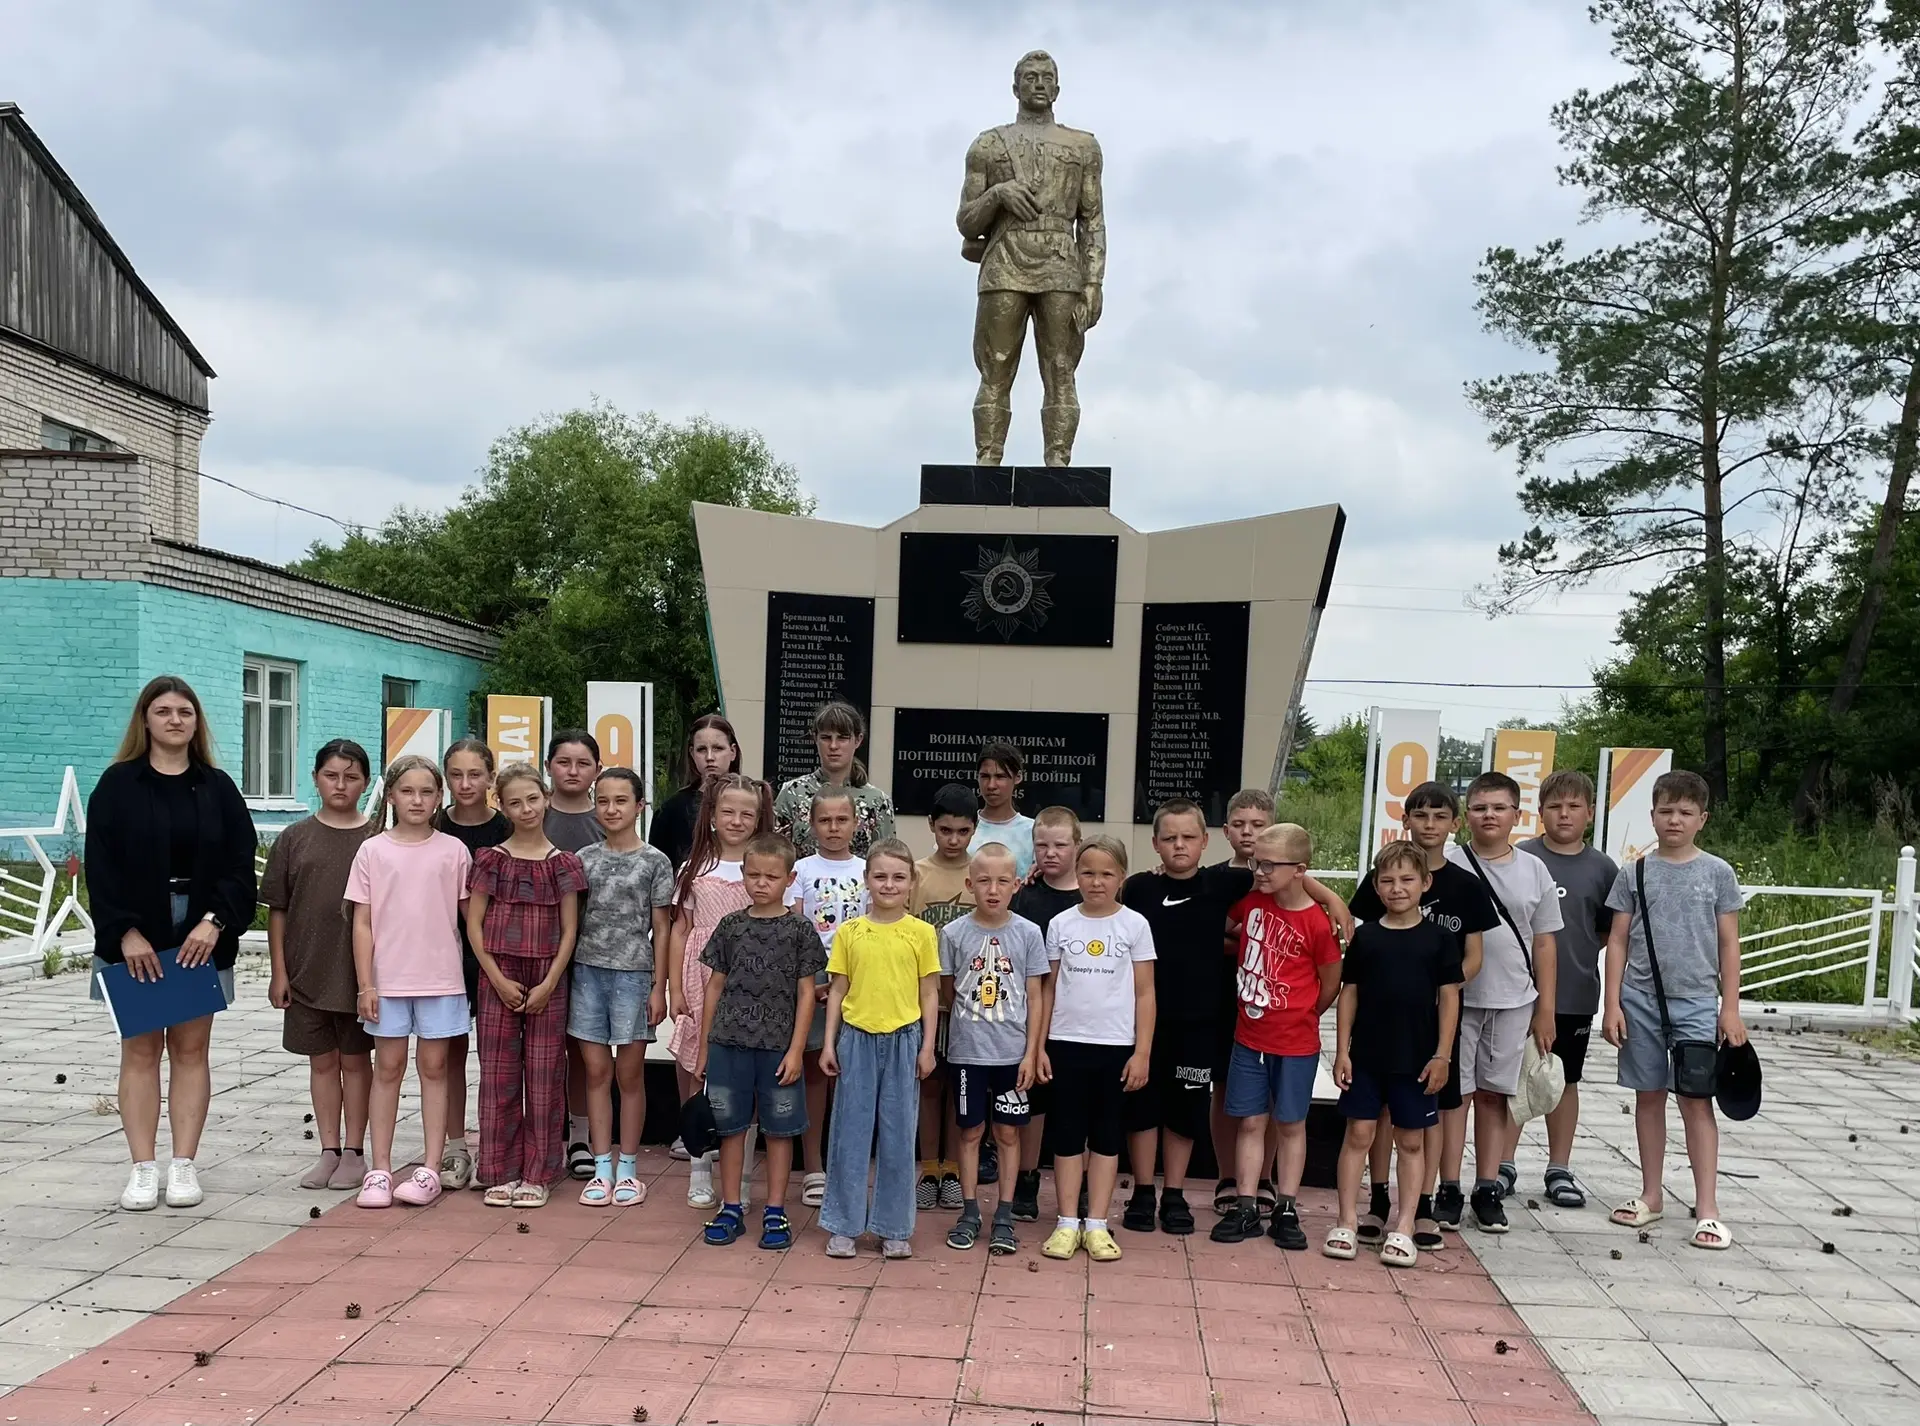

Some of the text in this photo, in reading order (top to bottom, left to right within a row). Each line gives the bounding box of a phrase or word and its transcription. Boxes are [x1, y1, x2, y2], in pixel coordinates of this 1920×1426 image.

[782, 622, 809, 631] Быков
[782, 632, 832, 642] Владимиров
[781, 651, 845, 661] Давыденко В.В.
[781, 661, 826, 669] Давыденко
[780, 670, 826, 679] Давыденко
[898, 750, 977, 762] ПОГИБШИМ
[1033, 753, 1096, 766] ВЕЛИКОЙ
[1032, 770, 1081, 783] ВОЙНЫ
[1246, 908, 1304, 958] GAME
[1243, 938, 1287, 981] DAY
[986, 986, 992, 995] 9
[1175, 1066, 1212, 1082] NIKE
[995, 1102, 1029, 1114] adidas
